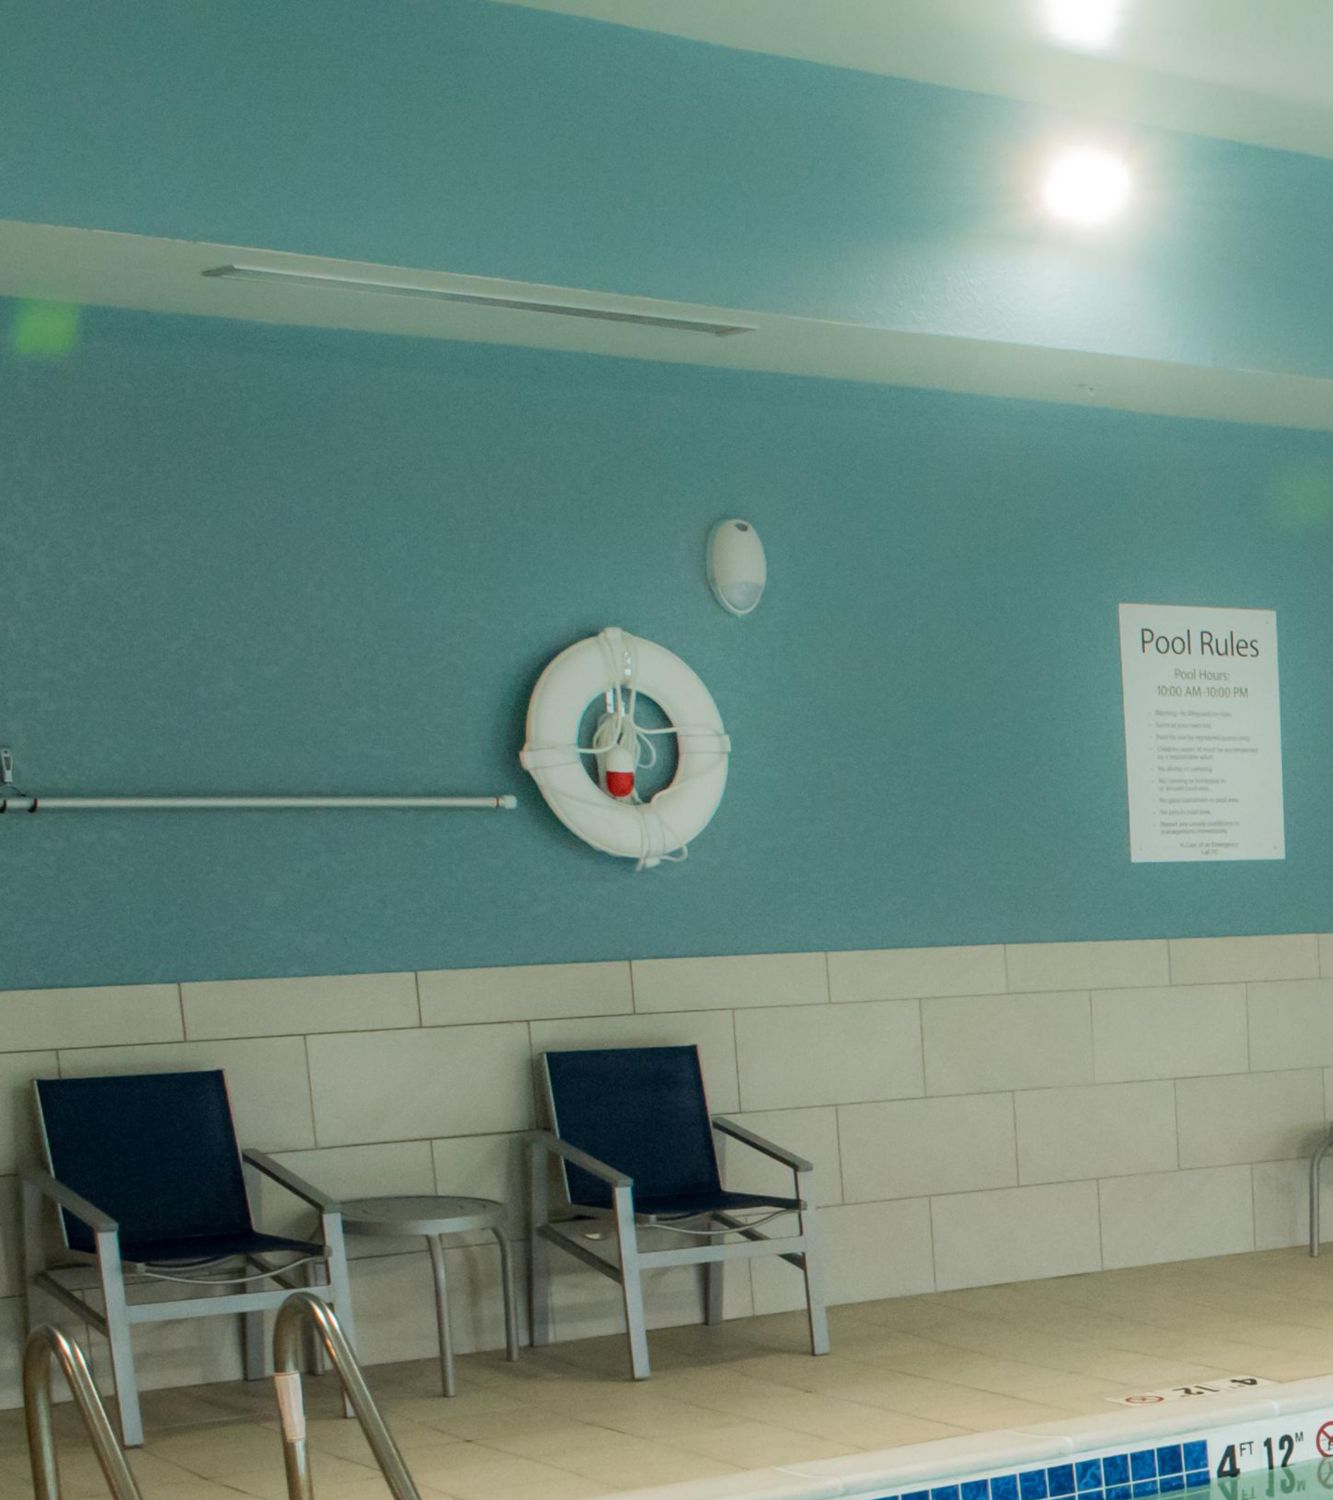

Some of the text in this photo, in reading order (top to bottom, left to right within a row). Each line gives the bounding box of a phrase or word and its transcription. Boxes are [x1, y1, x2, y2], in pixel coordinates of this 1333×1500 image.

[1141, 628, 1260, 657] Pool Rules
[1174, 668, 1196, 680] Pool
[1233, 687, 1249, 699] PM
